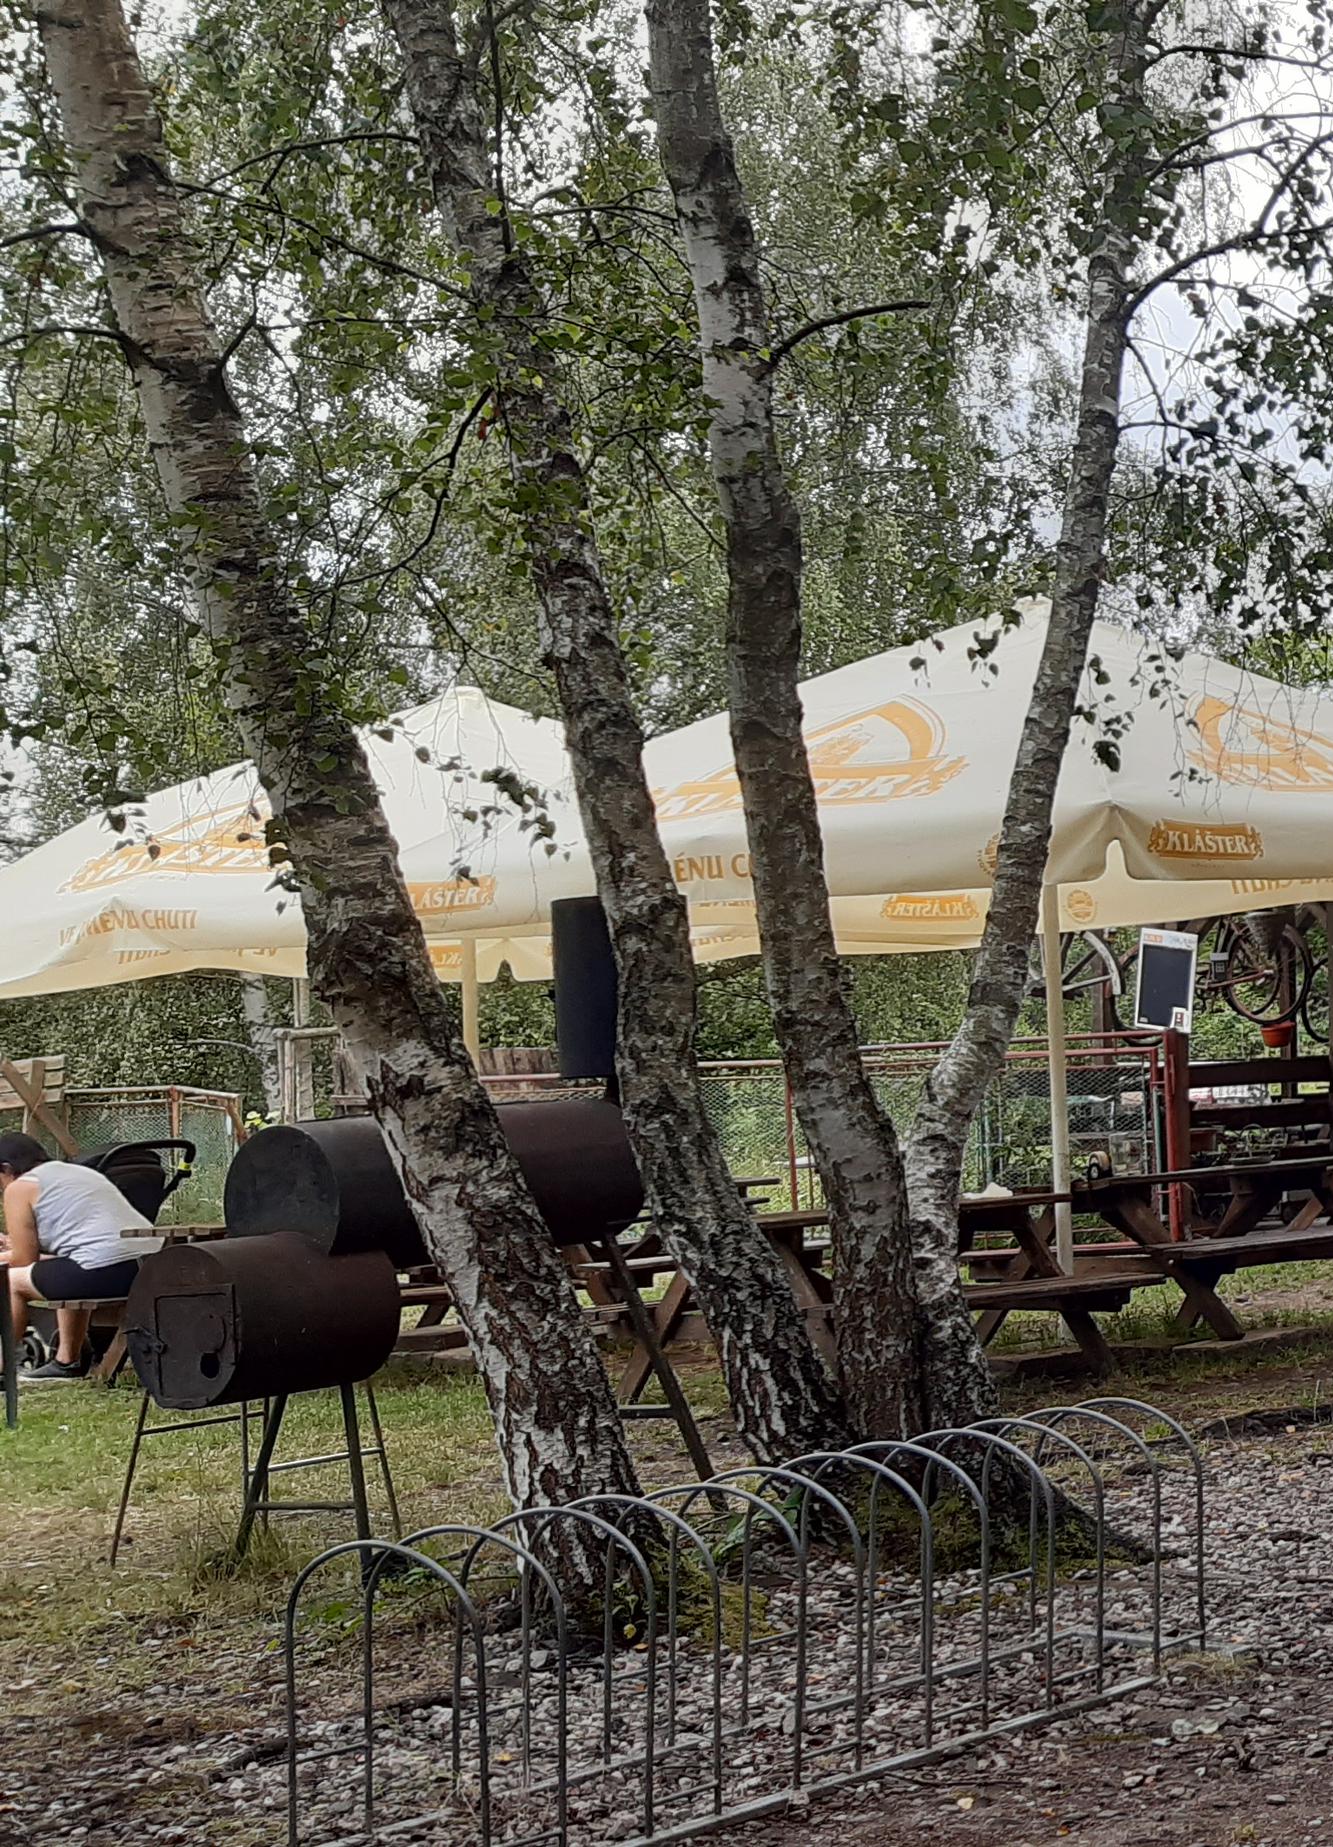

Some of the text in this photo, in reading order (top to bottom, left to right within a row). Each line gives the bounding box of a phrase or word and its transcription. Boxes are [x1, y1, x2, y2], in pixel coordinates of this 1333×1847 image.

[1166, 829, 1250, 854] KLÁŠTER
[673, 852, 723, 882] ÉNU
[410, 886, 481, 911] LÁŠTER
[141, 908, 198, 930] CHUTI
